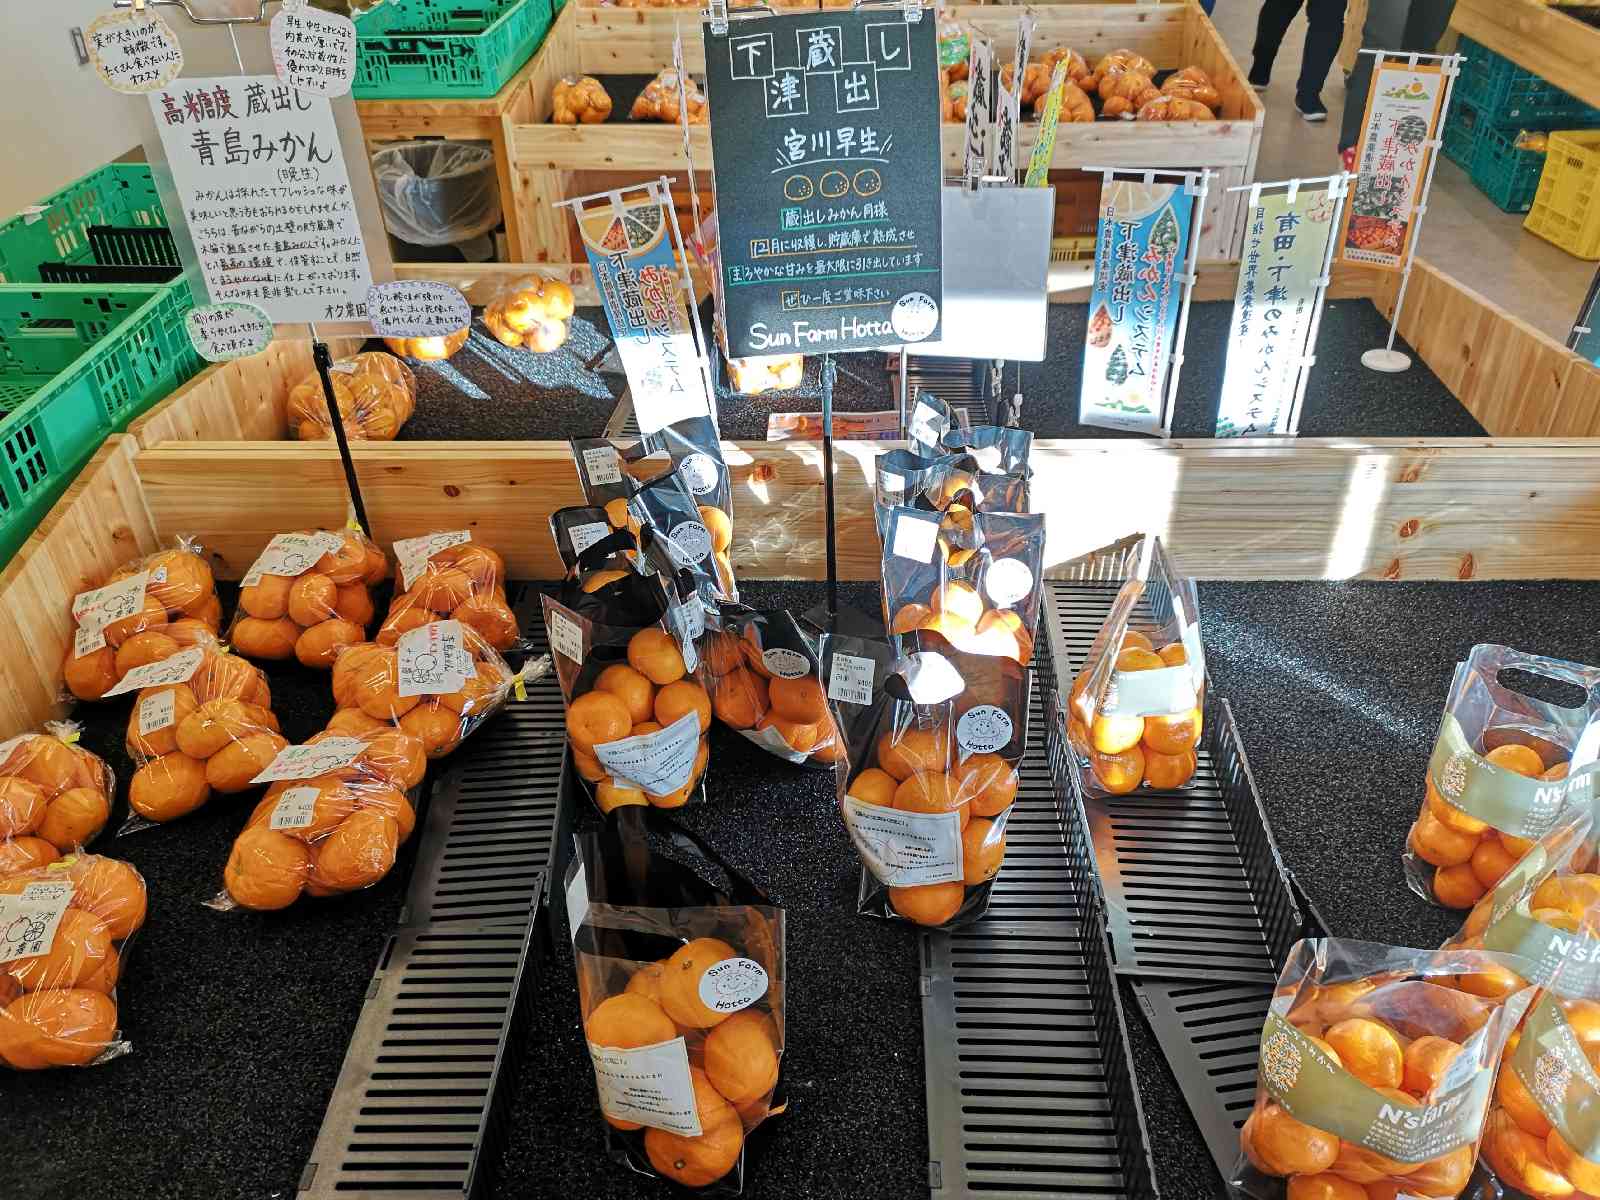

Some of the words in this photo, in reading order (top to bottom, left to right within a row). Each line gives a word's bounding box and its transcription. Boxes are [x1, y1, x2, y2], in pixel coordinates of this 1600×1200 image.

[161, 85, 239, 125] 高糖度
[244, 82, 311, 117] 蔵出し
[190, 127, 333, 166] 青島みかん
[784, 127, 880, 161] 宮川早生
[785, 201, 888, 228] 蔵出しみかん同様
[733, 253, 924, 281] まろやかな甘みを最大限に引き出しています
[749, 322, 792, 349] Sun
[793, 320, 838, 348] Farm
[841, 316, 894, 339] Hotta
[967, 709, 987, 719] Sun
[991, 710, 1011, 727] Farm
[966, 741, 994, 750] Hotta
[1548, 934, 1587, 961] N's
[708, 962, 731, 977] Sun
[738, 960, 764, 977] Farm
[715, 996, 752, 1010] Hotta
[1377, 1104, 1420, 1129] N's
